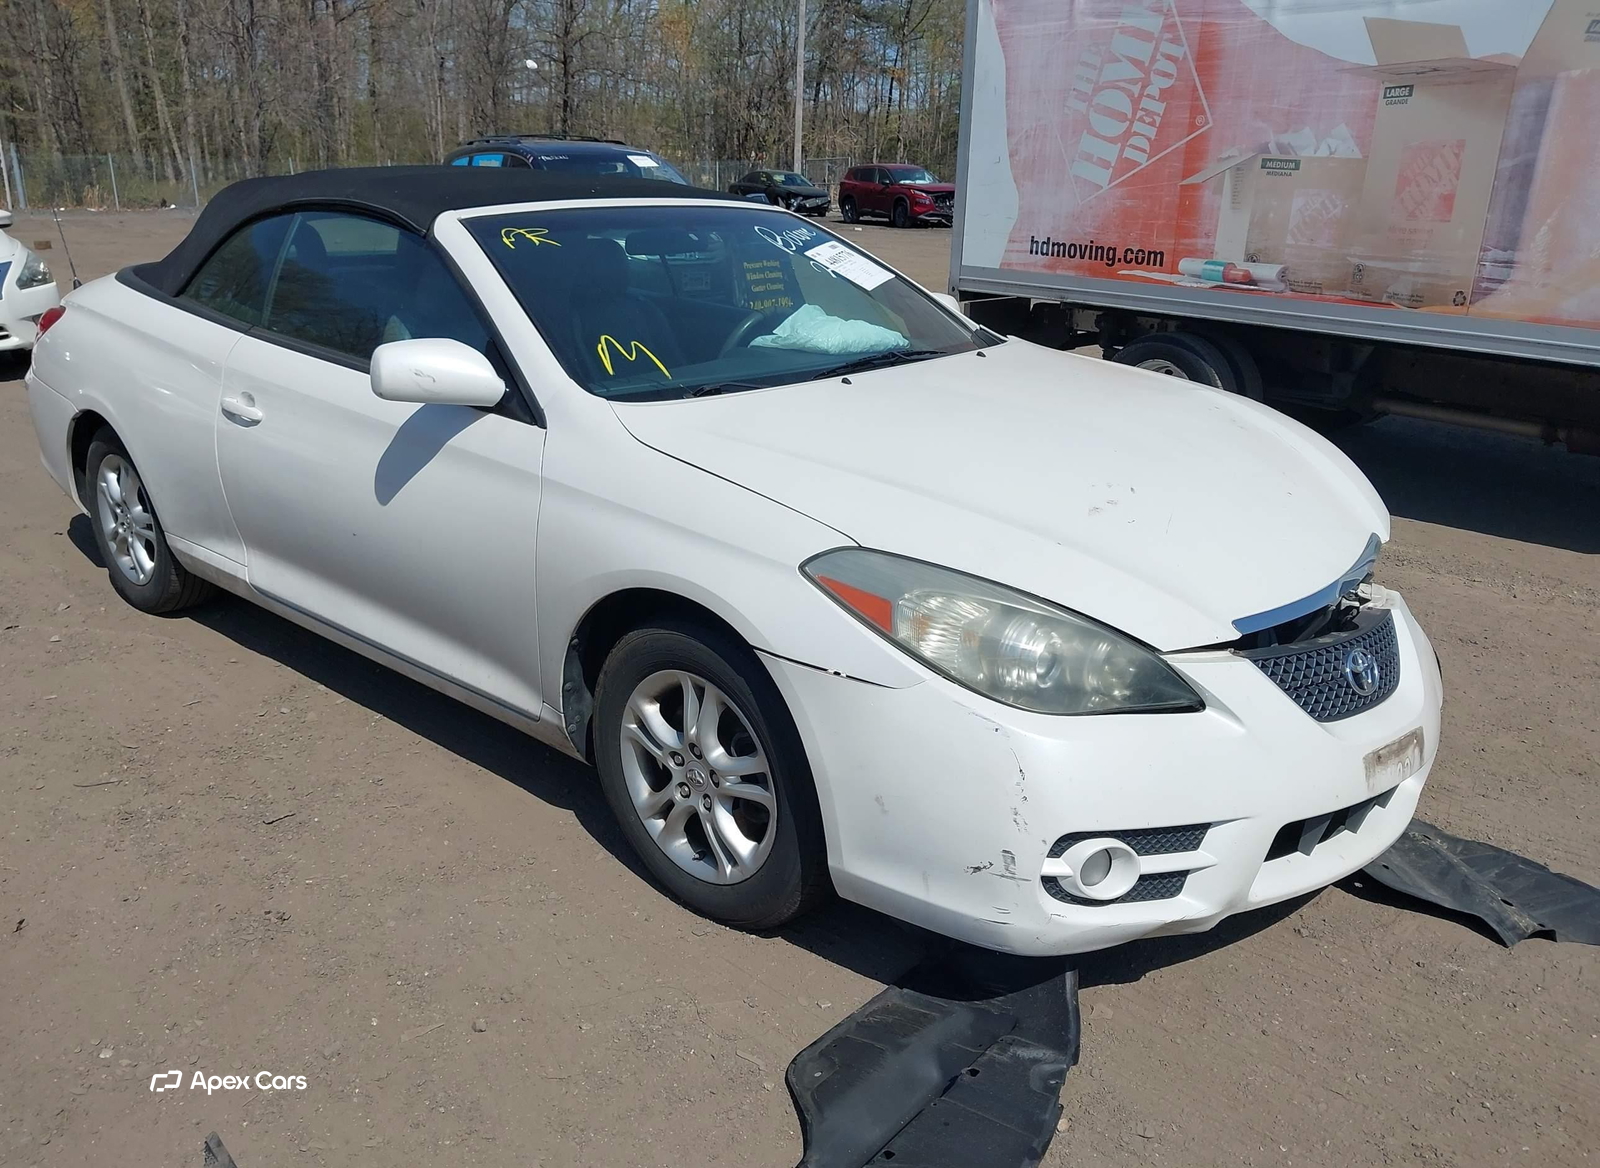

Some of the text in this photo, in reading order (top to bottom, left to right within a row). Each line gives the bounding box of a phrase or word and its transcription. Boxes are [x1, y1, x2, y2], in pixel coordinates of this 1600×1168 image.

[1122, 33, 1187, 165] DEPOT
[1385, 98, 1409, 106] GRANDE
[1386, 87, 1410, 97] LARGE
[1265, 161, 1296, 169] MEDIUM
[1029, 235, 1165, 267] hdmoving.com
[597, 334, 673, 381] M
